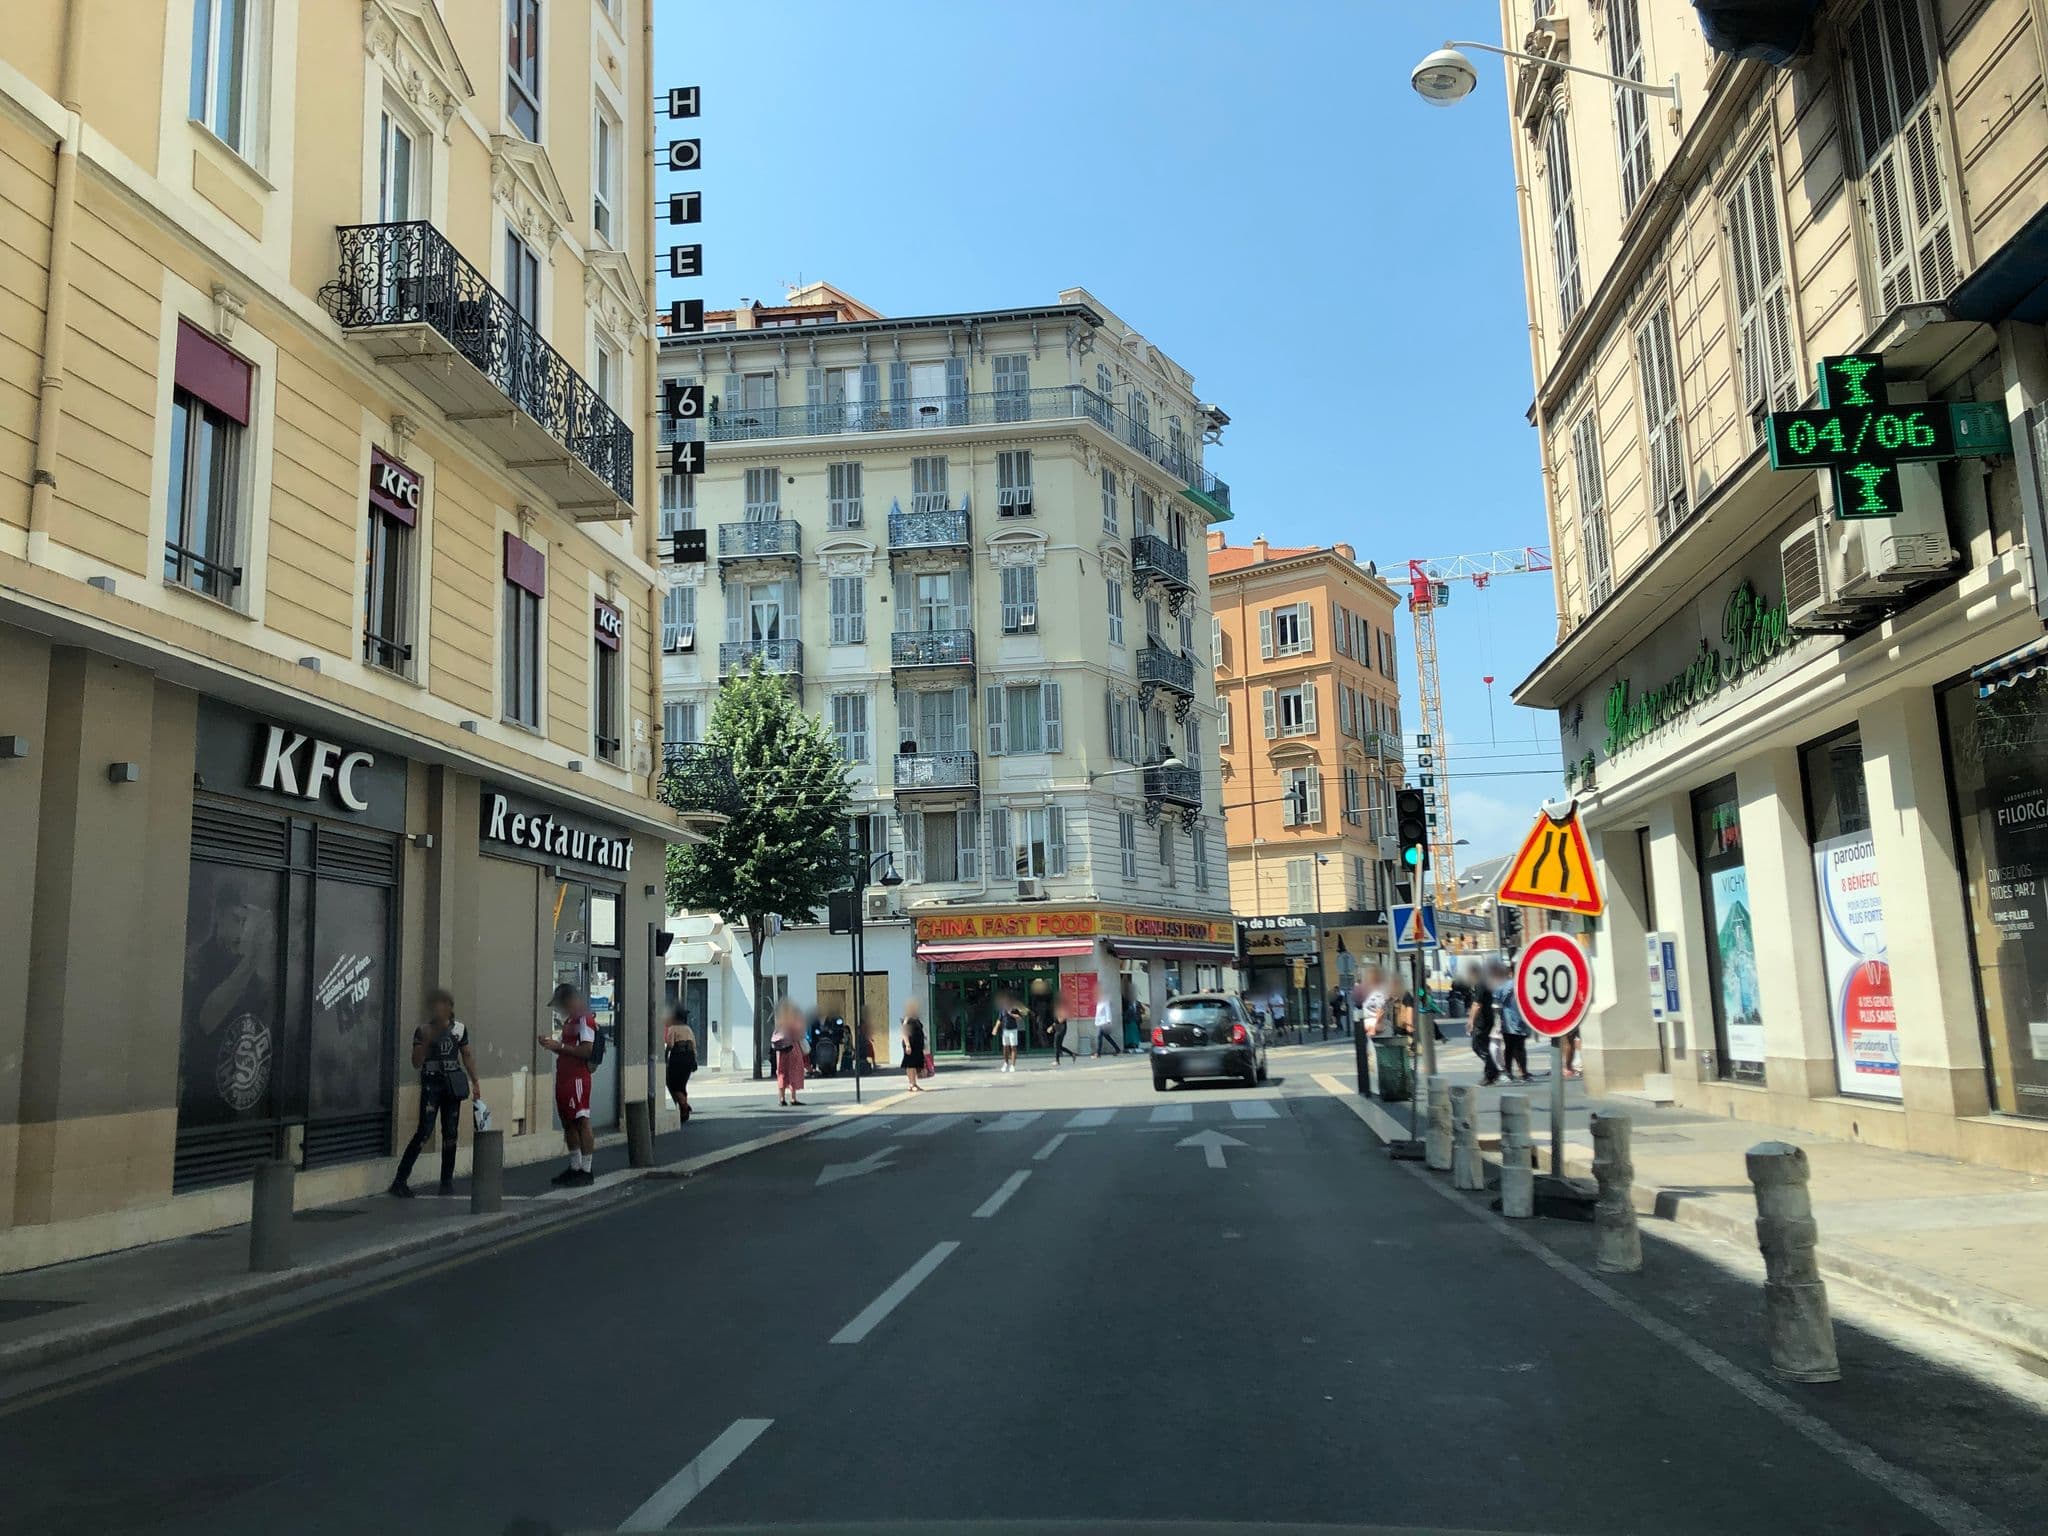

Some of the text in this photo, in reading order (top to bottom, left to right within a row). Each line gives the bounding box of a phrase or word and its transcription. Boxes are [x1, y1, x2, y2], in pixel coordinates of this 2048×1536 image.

[672, 88, 697, 473] HOTEL 64
[1788, 413, 1935, 454] 04/06
[380, 464, 420, 509] KFC
[599, 608, 622, 638] KFC
[259, 725, 375, 812] KFC
[1420, 736, 1435, 825] HOTEL
[1997, 799, 2048, 826] FILORG
[487, 794, 635, 873] Restaurant
[1991, 881, 2036, 900] RIDES PAR 2
[917, 917, 978, 938] CHINA
[982, 916, 1031, 936] FAST
[1036, 913, 1094, 935] FOOD
[1135, 918, 1163, 937] CHINA
[1249, 917, 1264, 929] de
[1265, 917, 1276, 928] la
[1277, 915, 1306, 928] Gare
[1532, 964, 1572, 1006] 30
